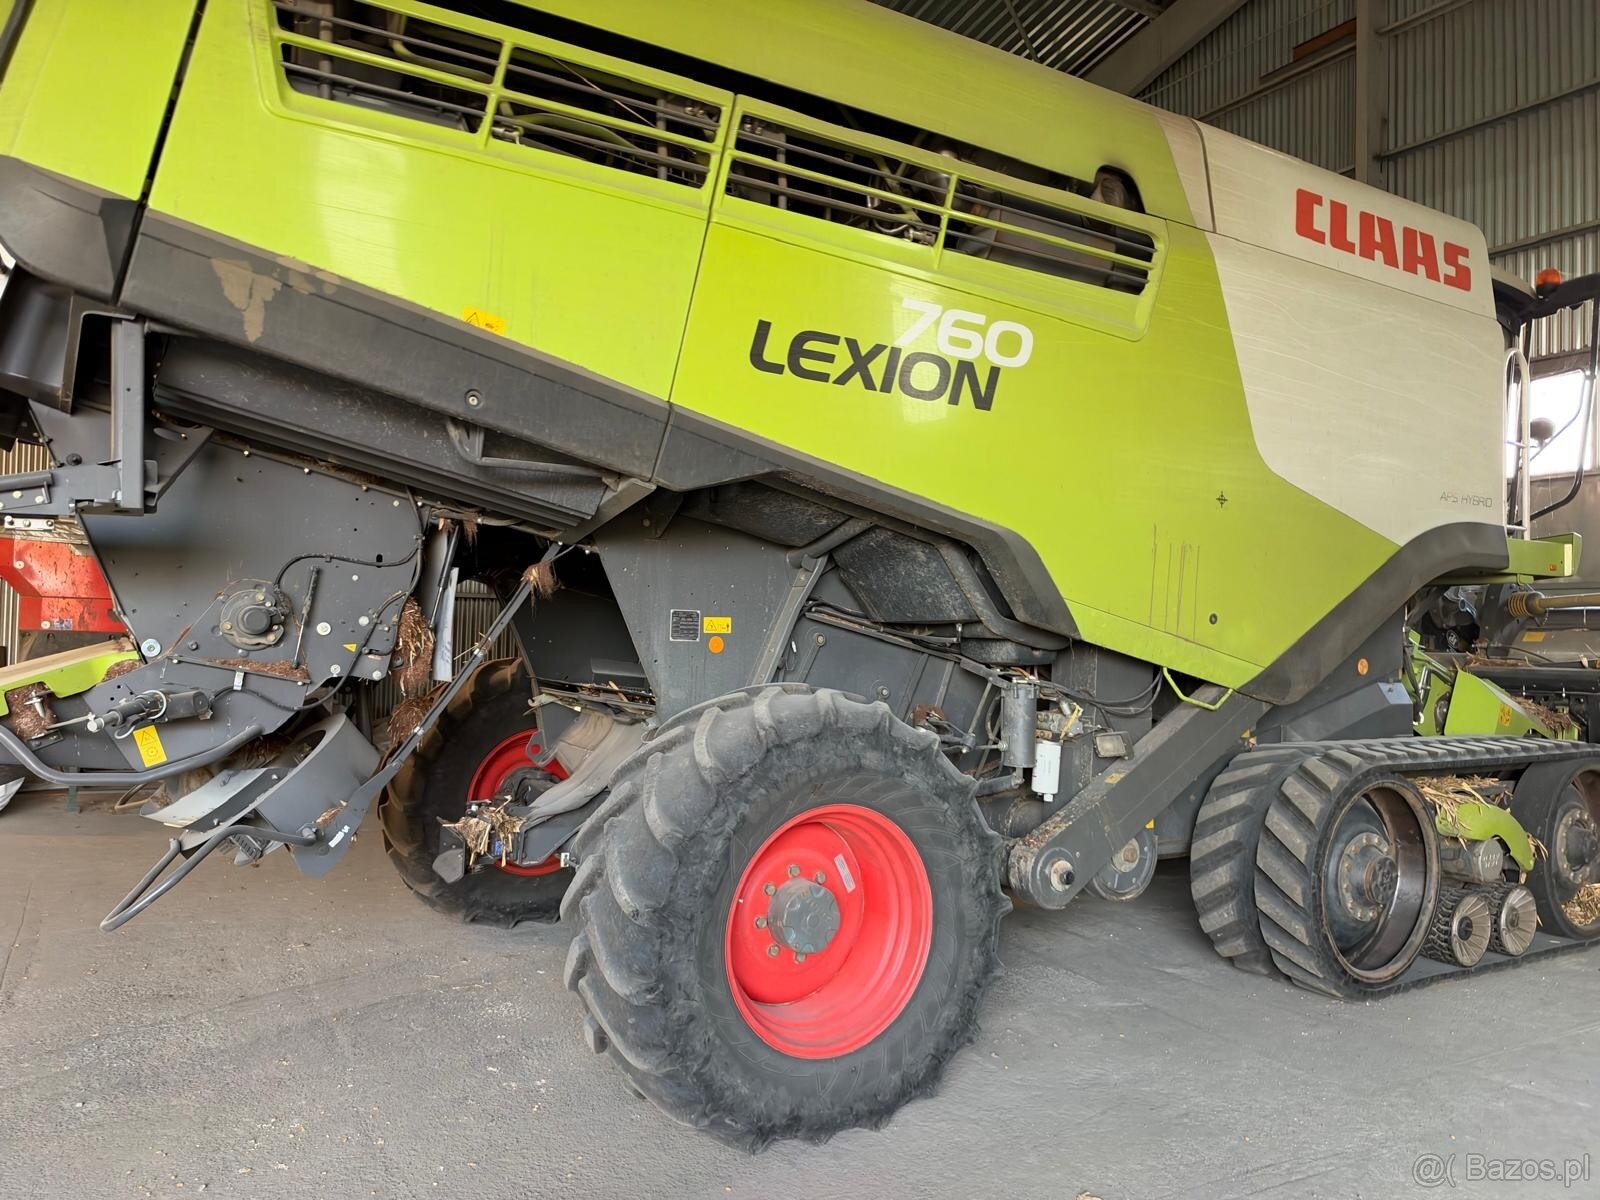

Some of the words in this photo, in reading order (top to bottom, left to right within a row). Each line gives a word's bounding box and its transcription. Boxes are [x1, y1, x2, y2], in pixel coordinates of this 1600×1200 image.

[1296, 188, 1472, 292] CLAAS
[749, 319, 1001, 412] LEXION
[892, 297, 1034, 368] 760
